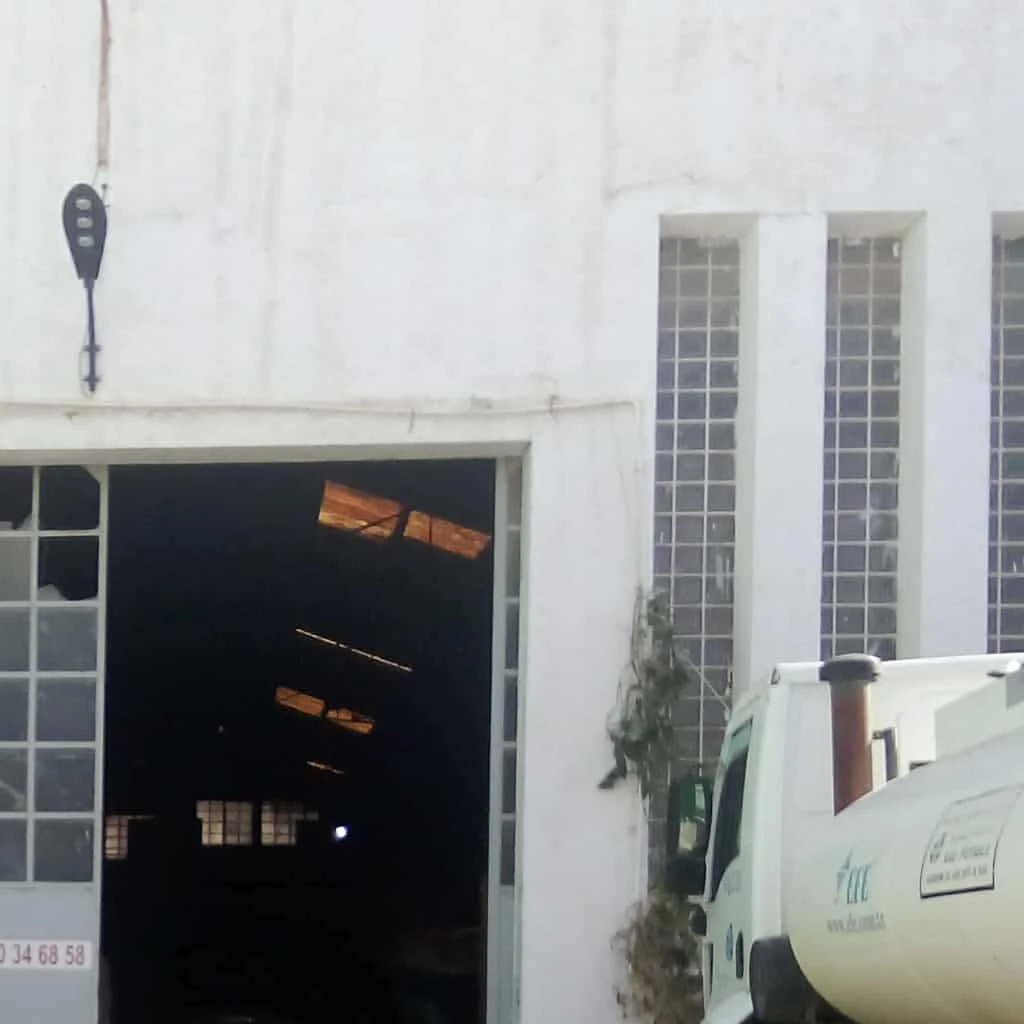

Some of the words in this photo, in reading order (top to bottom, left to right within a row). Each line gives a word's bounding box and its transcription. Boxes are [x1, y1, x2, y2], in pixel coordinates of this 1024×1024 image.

[13, 944, 31, 964] 34
[38, 944, 58, 965] 68
[65, 945, 85, 965] 58
